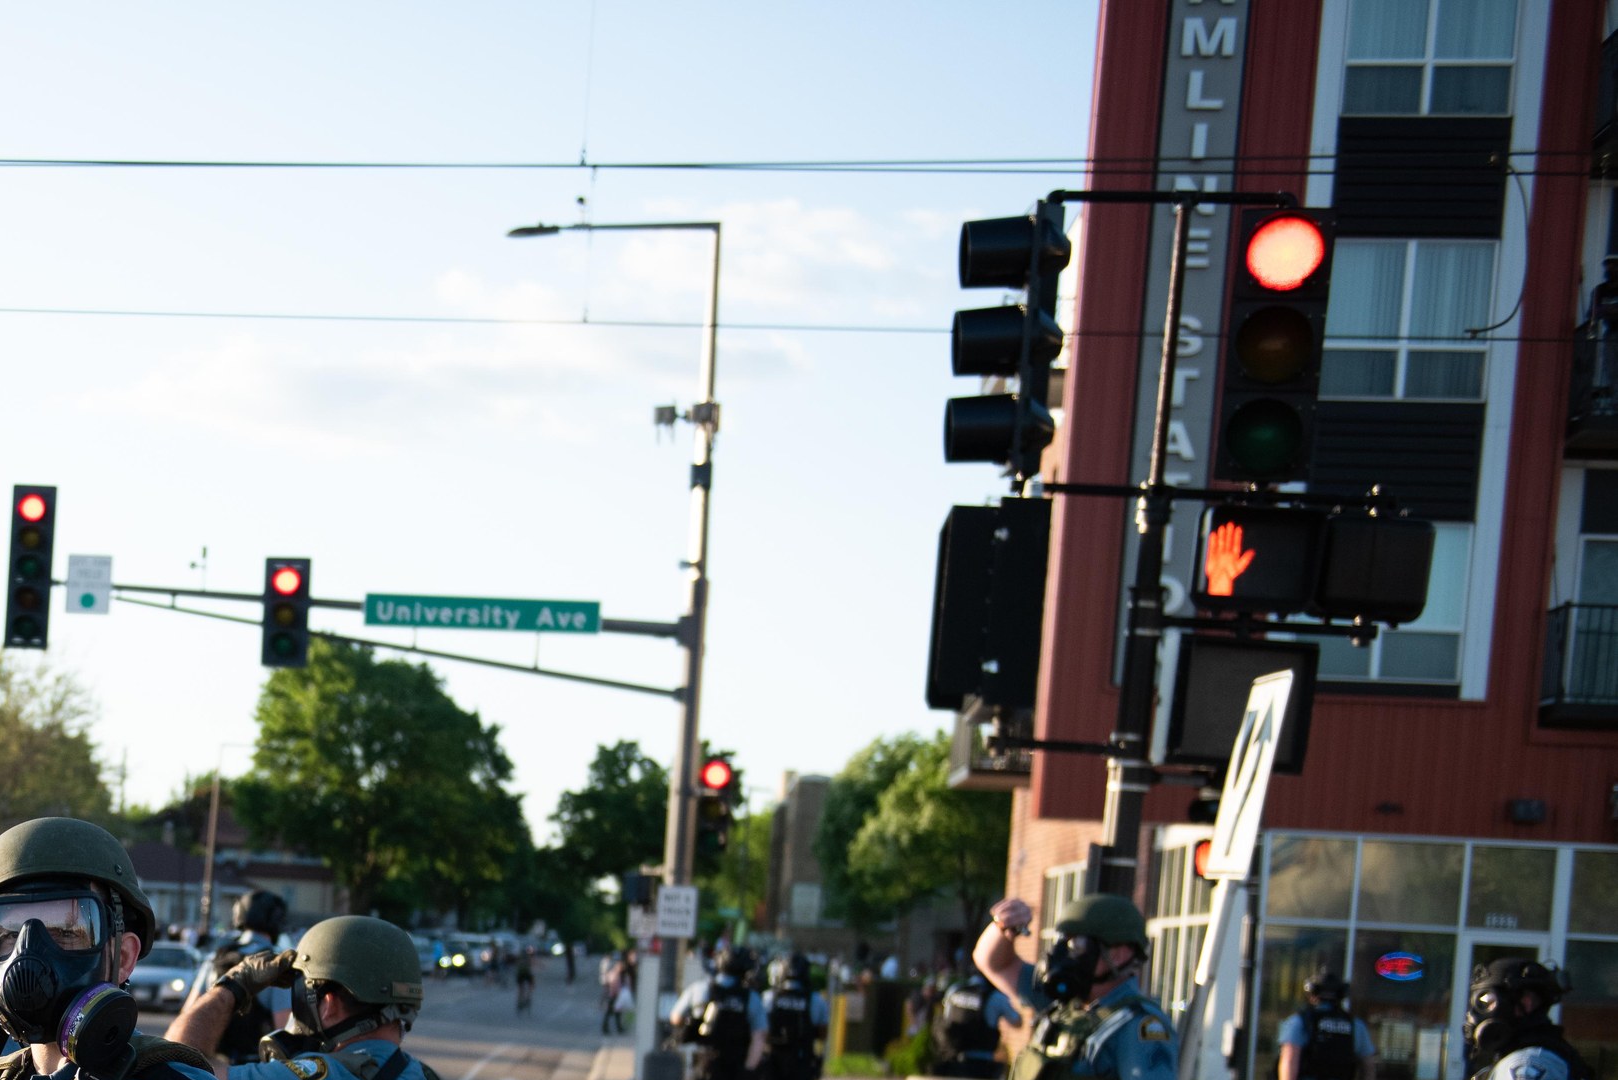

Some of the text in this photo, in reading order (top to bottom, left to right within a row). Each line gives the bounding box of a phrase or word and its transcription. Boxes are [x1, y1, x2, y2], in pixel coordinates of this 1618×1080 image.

[1172, 0, 1238, 268] MLINE
[376, 600, 587, 630] University Ave
